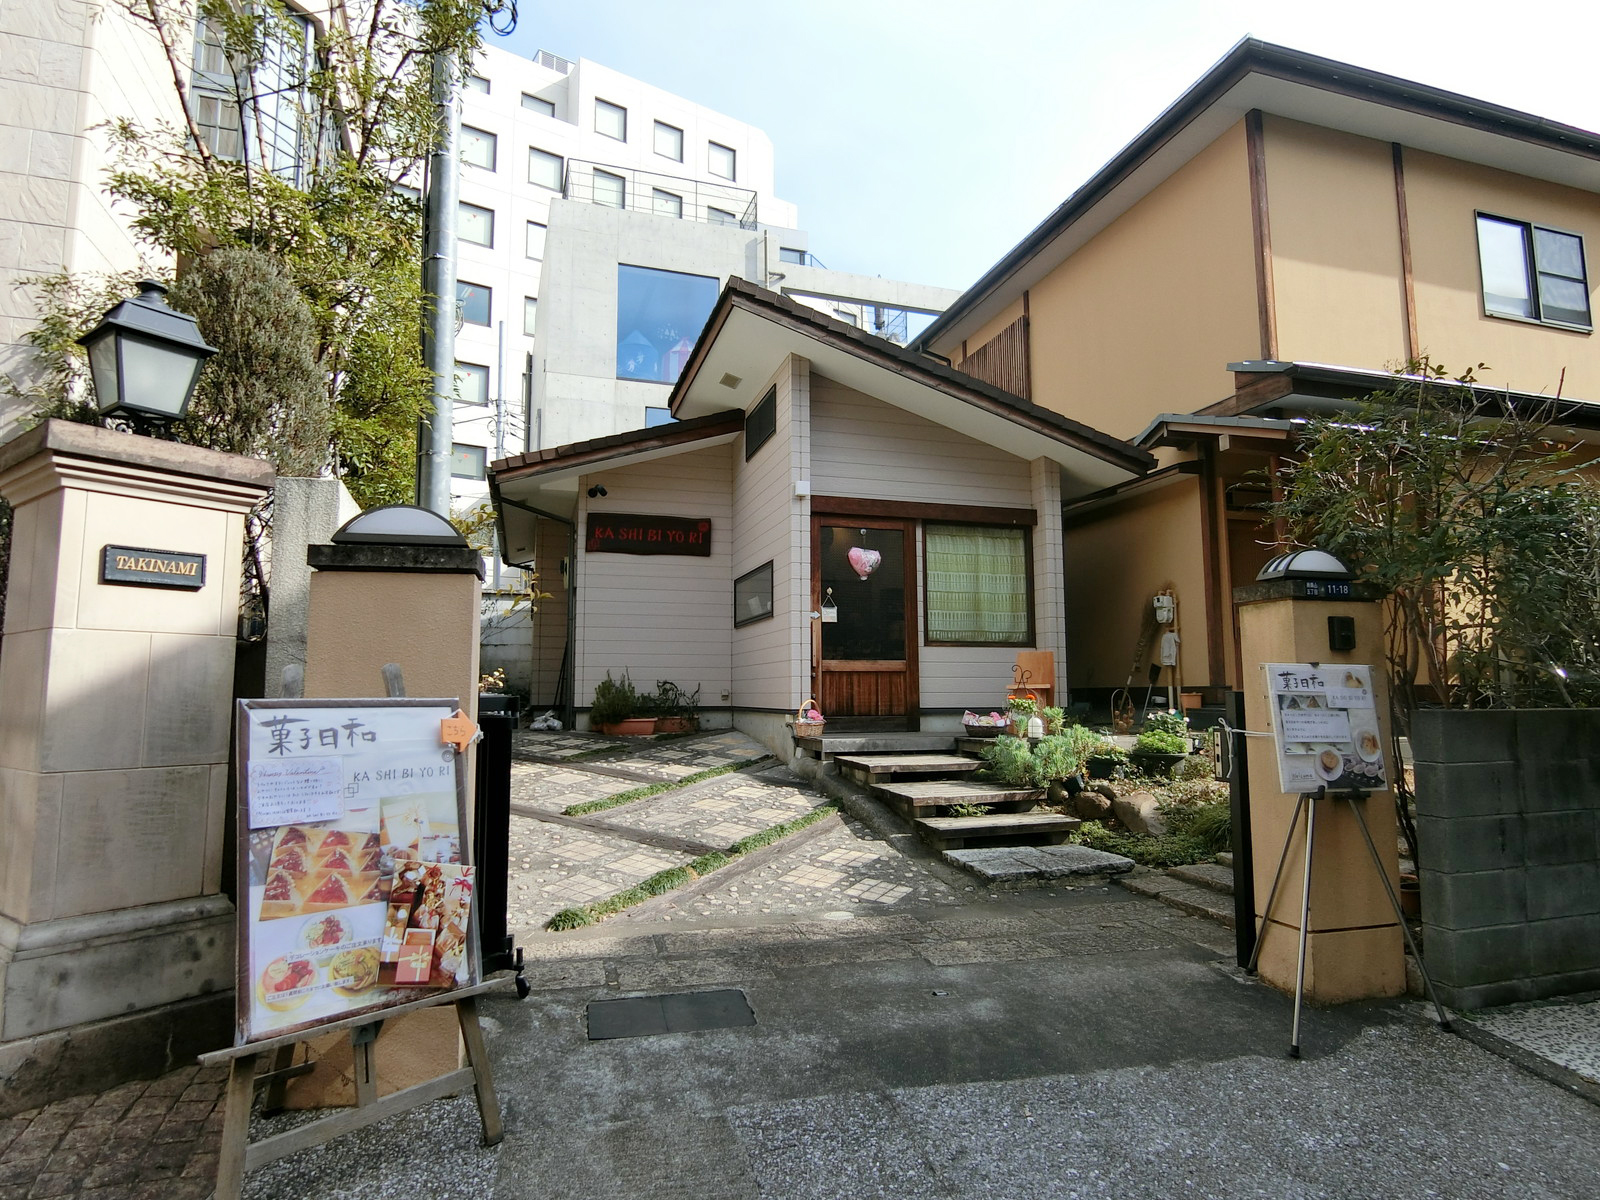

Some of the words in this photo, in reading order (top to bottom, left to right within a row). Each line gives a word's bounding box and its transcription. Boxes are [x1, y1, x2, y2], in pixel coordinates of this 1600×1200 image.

[594, 527, 614, 539] KA
[619, 528, 643, 541] SHI
[648, 529, 663, 541] BI
[667, 530, 685, 543] YO
[689, 532, 703, 544] RI
[116, 555, 198, 576] TAKINAMI
[1327, 584, 1349, 595] 11-18
[1277, 670, 1325, 690] 菓子日和
[260, 714, 377, 756] 菓子日和
[446, 725, 467, 737] こちら
[353, 771, 370, 783] KA
[375, 769, 396, 782] SHI
[402, 768, 414, 779] BI
[419, 766, 434, 777] YO
[439, 765, 450, 776] RI
